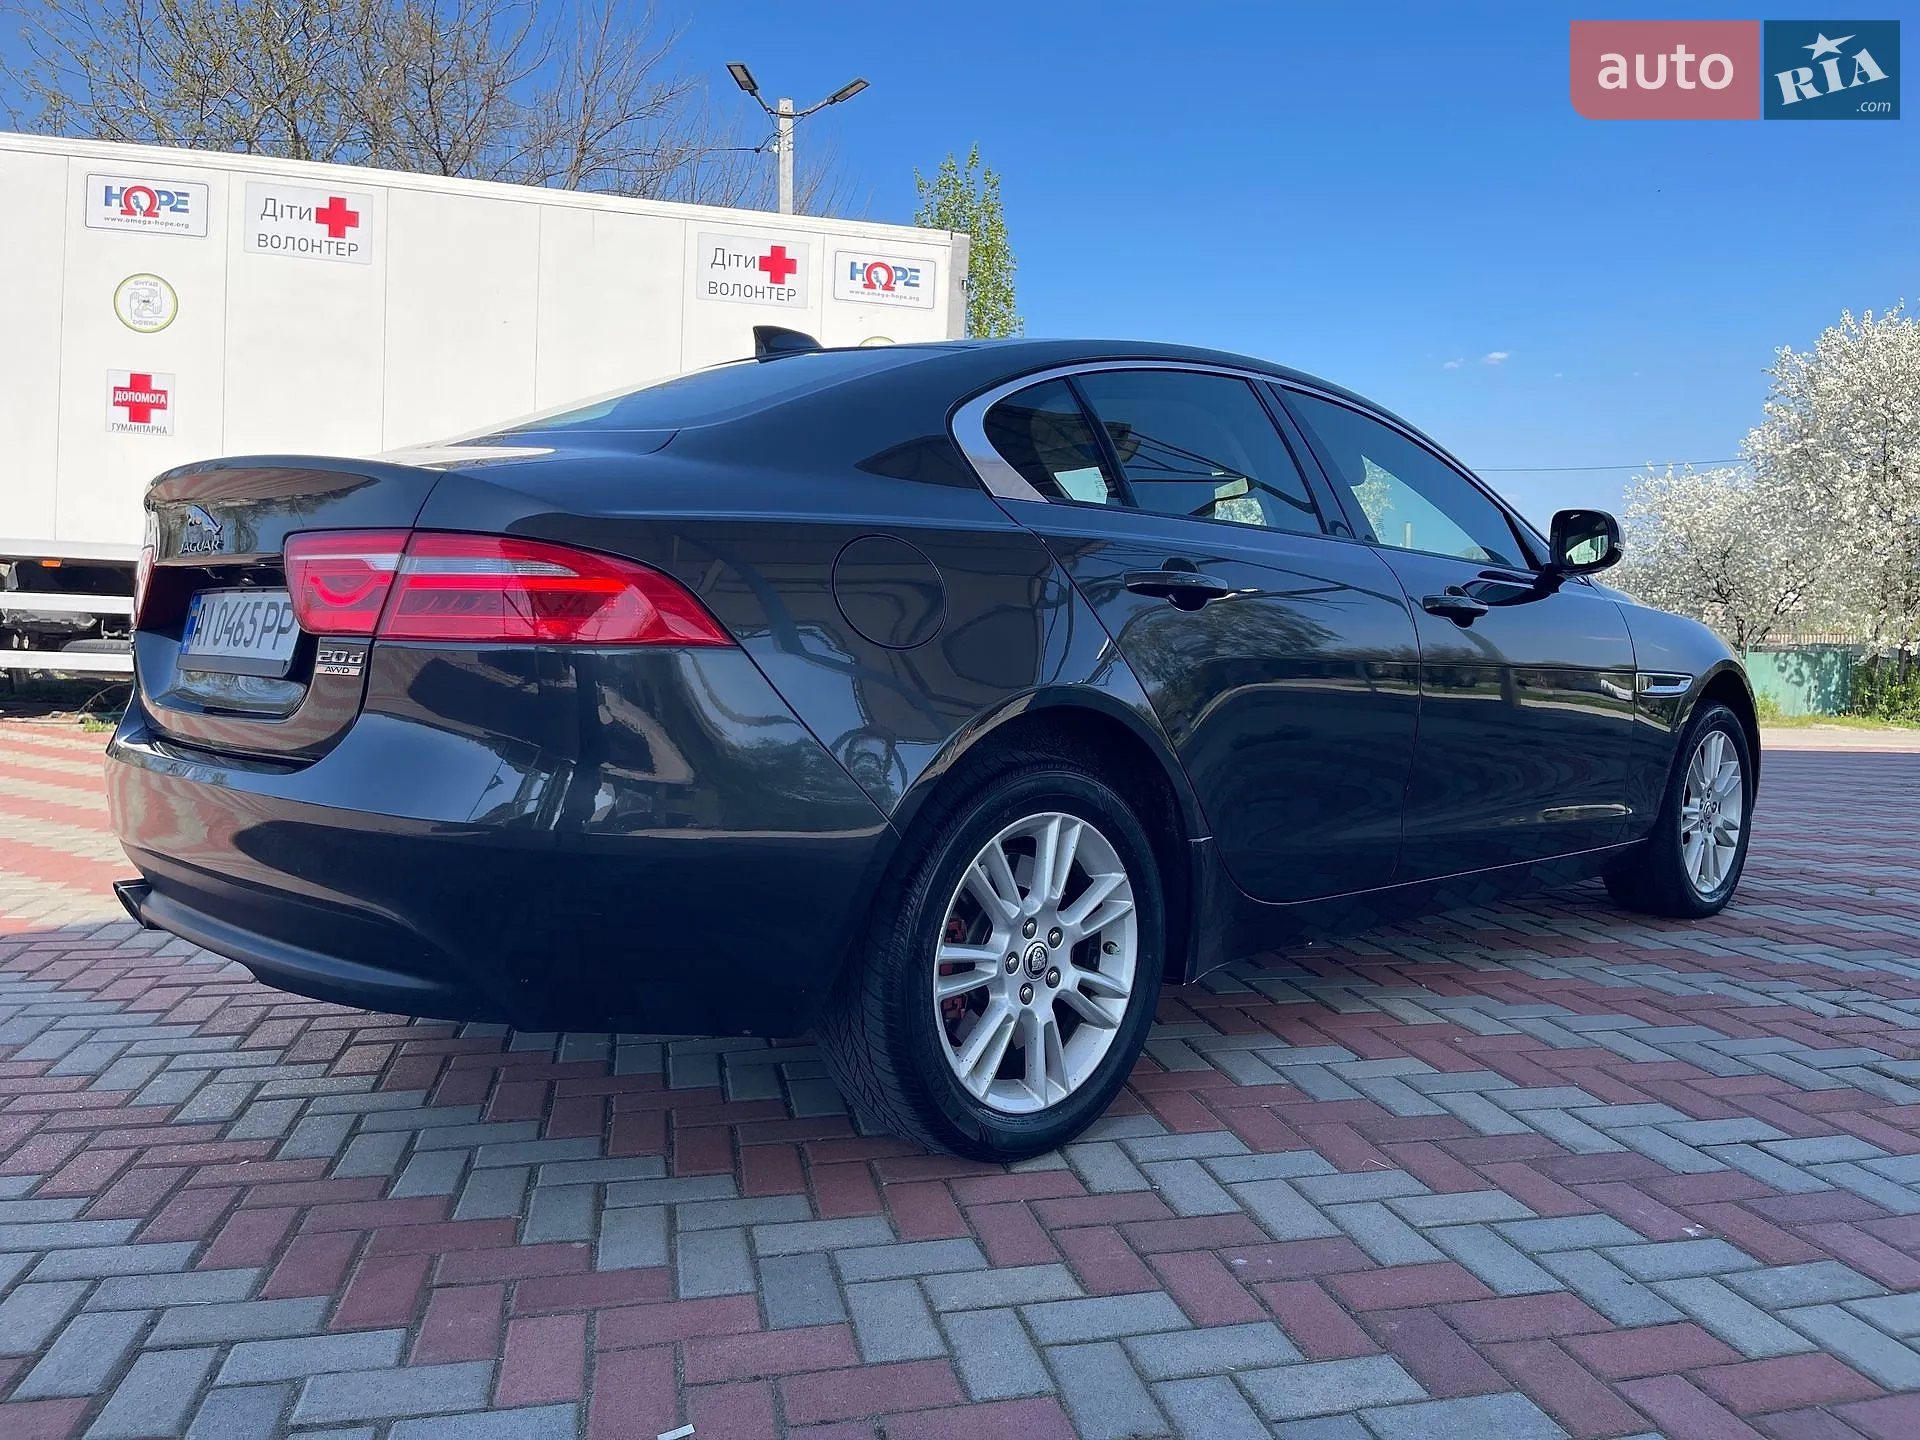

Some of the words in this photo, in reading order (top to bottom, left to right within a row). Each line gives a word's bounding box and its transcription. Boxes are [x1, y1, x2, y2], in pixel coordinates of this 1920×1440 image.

[104, 216, 190, 229] www.omega-hope.org
[257, 233, 359, 257] ВОЛОНТЕР
[708, 281, 797, 302] ВОЛОНТЕР
[114, 390, 167, 405] ДОПОМОГА
[111, 422, 168, 434] ГУМАНІТАРНА
[178, 540, 222, 554] JAGUAR
[316, 650, 365, 664] 20d
[325, 666, 350, 674] AWD
